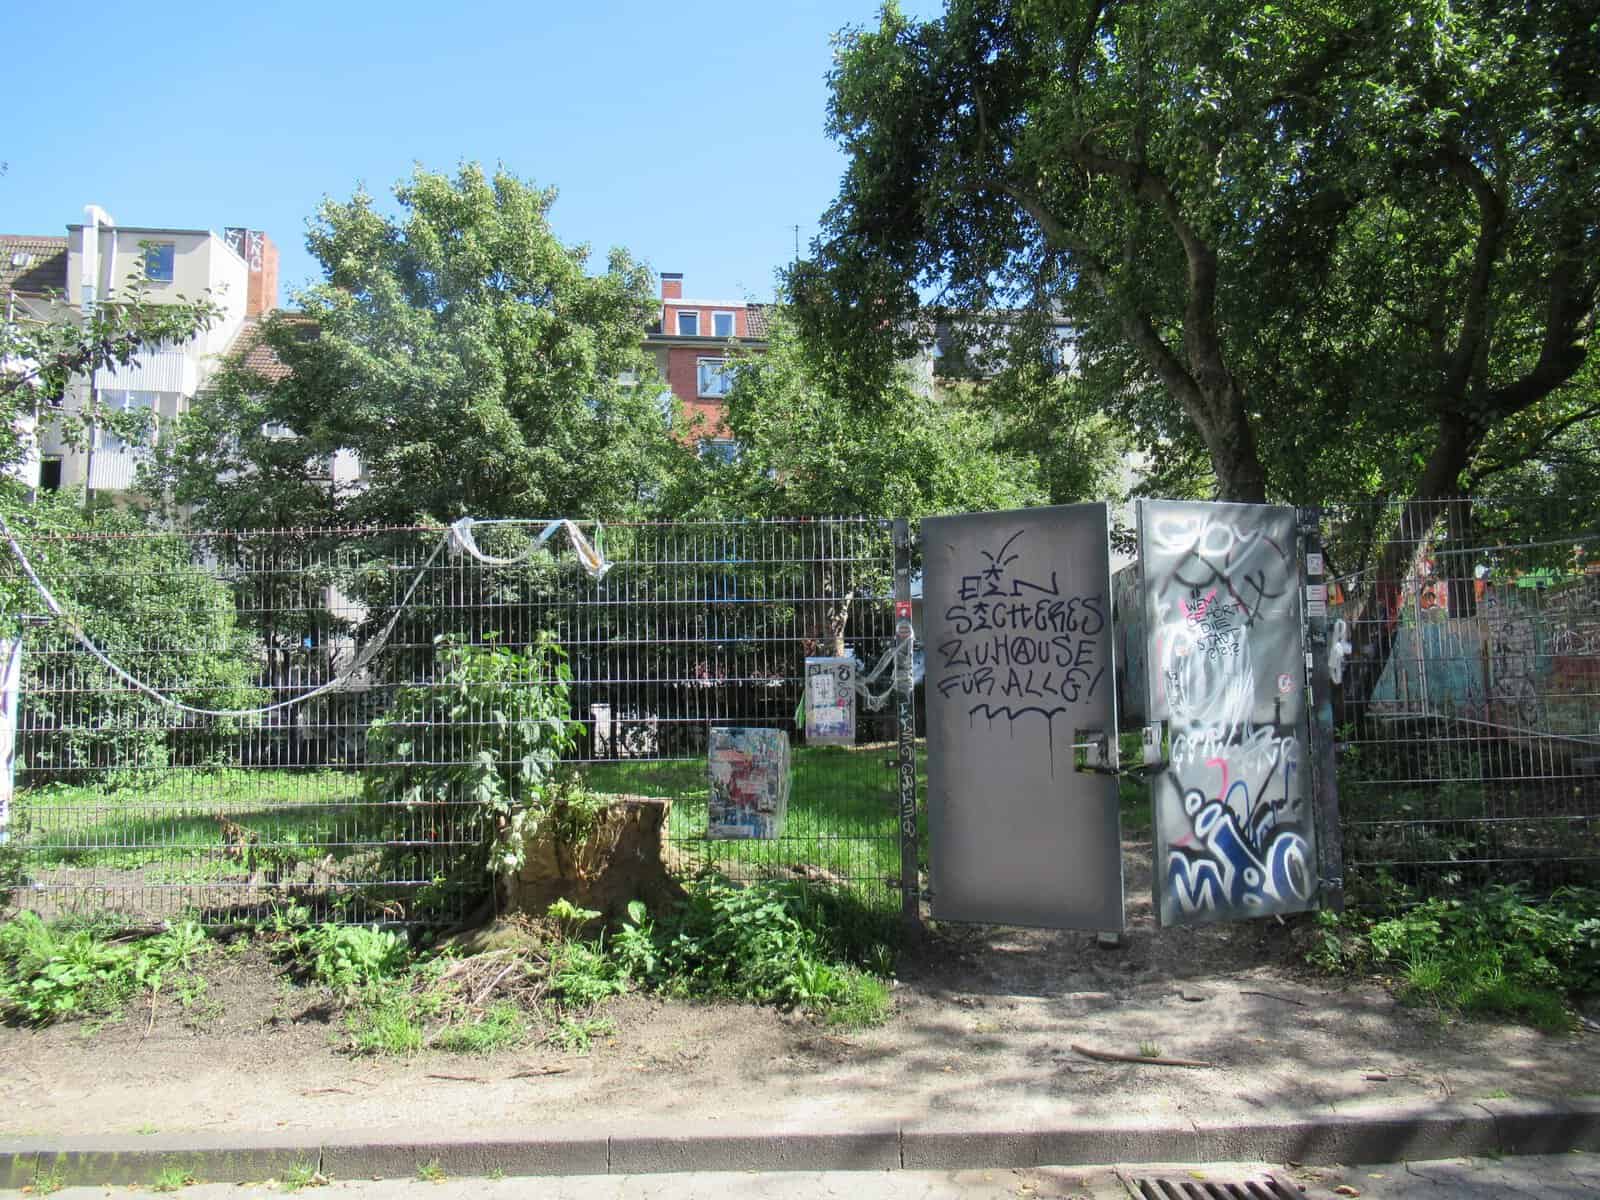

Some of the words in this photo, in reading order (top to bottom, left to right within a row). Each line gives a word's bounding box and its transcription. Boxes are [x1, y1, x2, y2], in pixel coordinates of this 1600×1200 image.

[957, 565, 1059, 601] EIN
[945, 597, 1105, 636] SICHERES
[1200, 617, 1232, 634] DIE
[938, 634, 1097, 668] ZUHAUSE
[937, 666, 996, 698] FÜR
[1001, 666, 1105, 704] ALLE!
